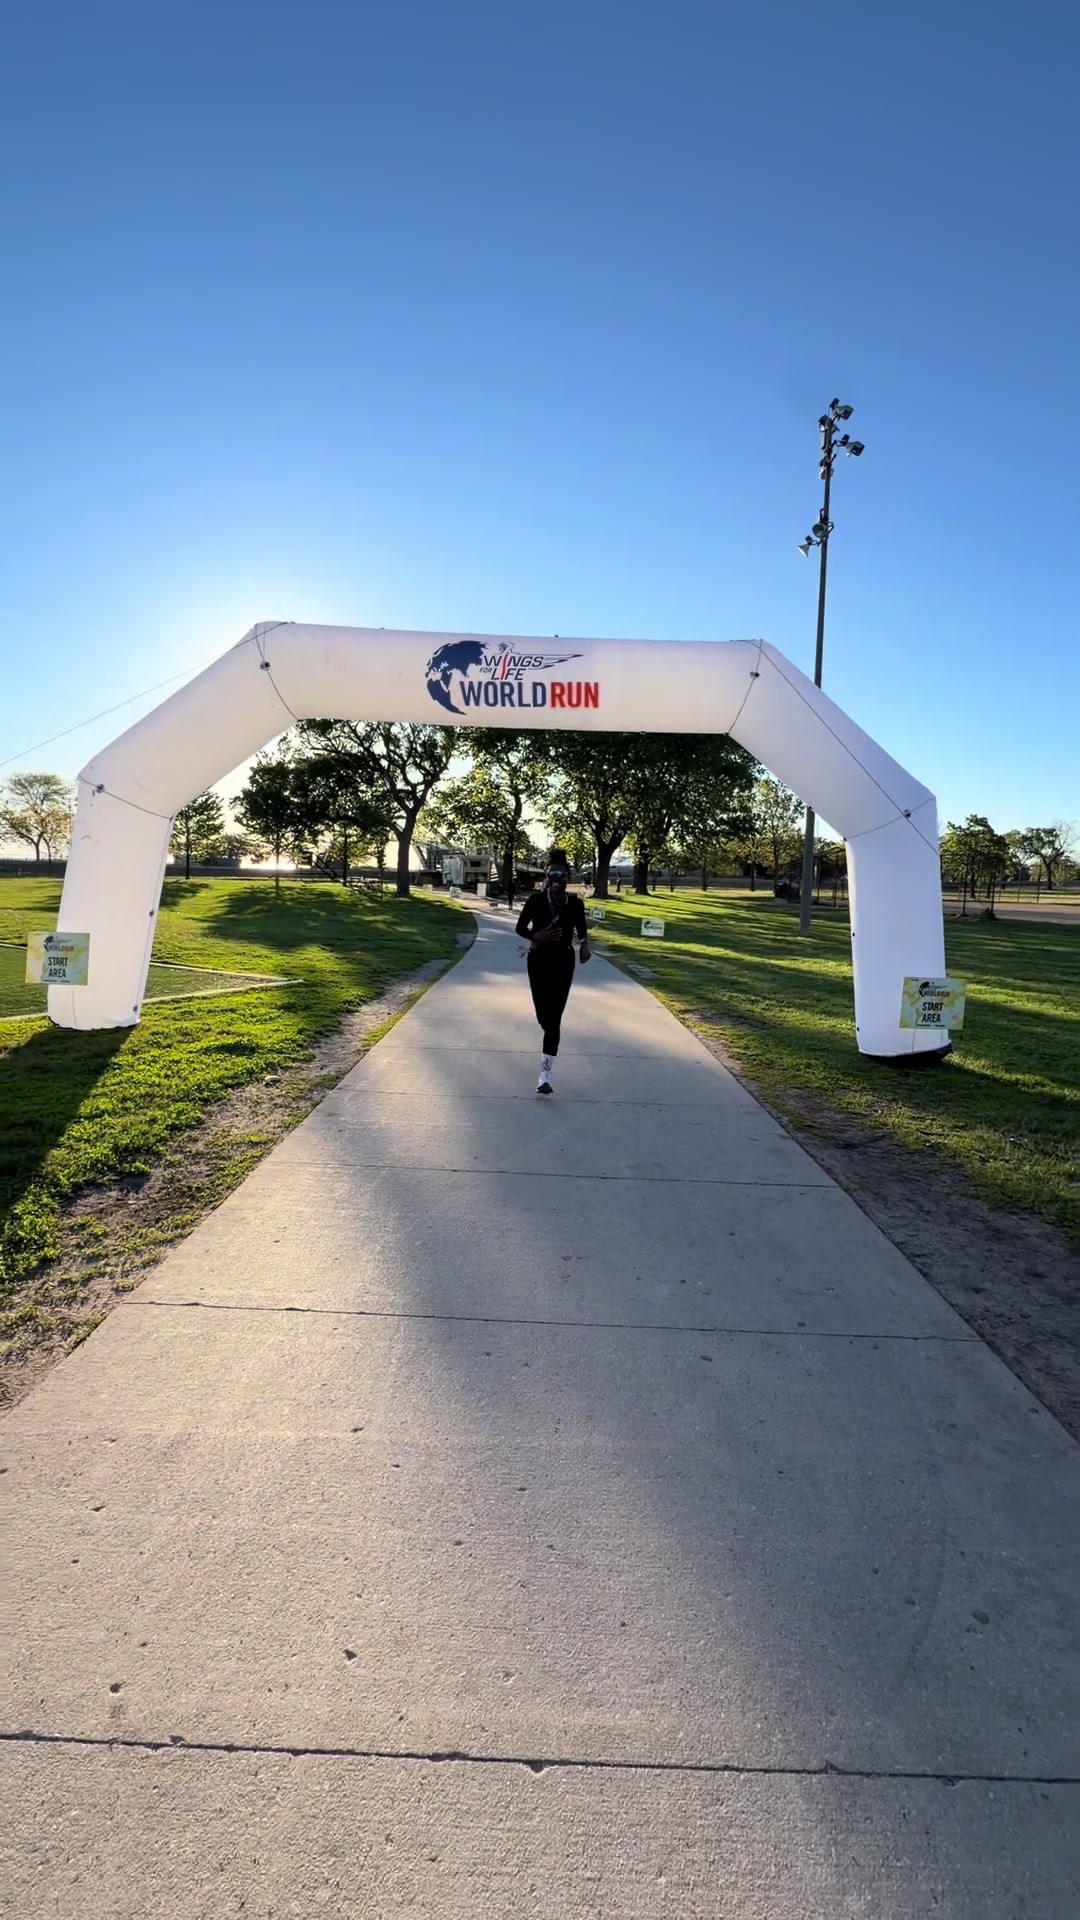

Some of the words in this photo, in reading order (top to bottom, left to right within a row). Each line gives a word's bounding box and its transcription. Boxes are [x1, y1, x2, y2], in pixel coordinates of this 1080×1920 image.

[484, 654, 544, 667] WINGS
[491, 667, 527, 681] LIFE
[459, 681, 547, 707] WORLD
[551, 682, 599, 708] RUN
[48, 956, 68, 966] START
[48, 968, 66, 978] AREA
[922, 1002, 943, 1011] START
[921, 1013, 941, 1022] AREA
